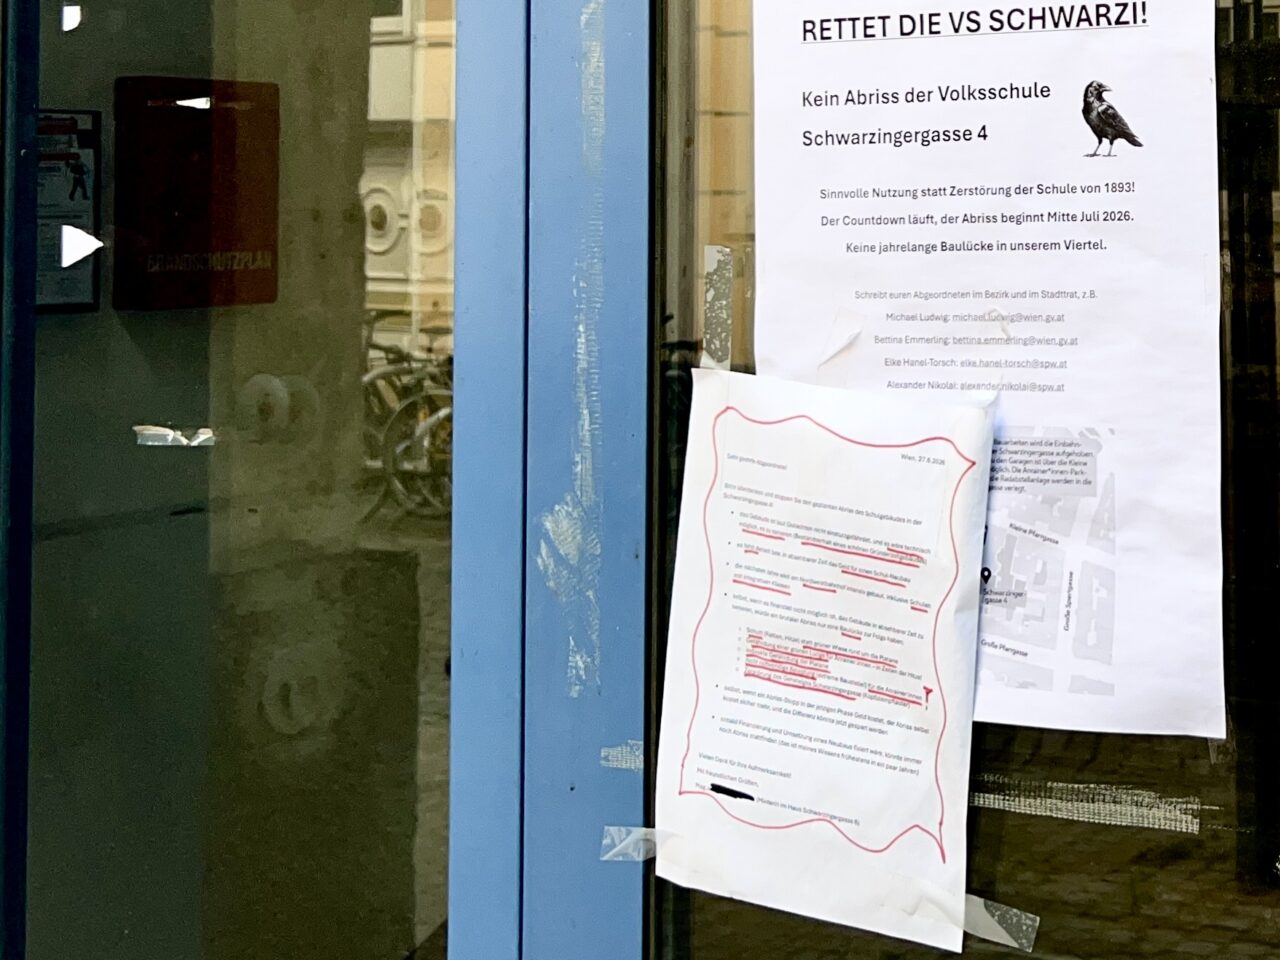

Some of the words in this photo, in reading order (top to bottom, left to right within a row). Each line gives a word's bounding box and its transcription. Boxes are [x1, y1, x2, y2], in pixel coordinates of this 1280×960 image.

[802, 15, 891, 40] RETTET
[899, 12, 941, 35] DIE
[948, 10, 981, 32] VS
[988, 0, 1148, 30] SCHWARZI!
[802, 90, 839, 107] Kein
[844, 88, 899, 105] Abriss
[904, 87, 934, 103] der
[937, 82, 1051, 101] Volksschule
[802, 128, 972, 147] Schwarzingergasse
[976, 124, 988, 140] 4
[819, 188, 869, 199] Sinnvolle
[871, 187, 918, 200] Nutzung
[920, 186, 947, 197] statt
[948, 185, 1012, 197] Zerstörung
[1013, 184, 1034, 195] der
[1036, 183, 1077, 194] Schule
[1079, 184, 1101, 193] von
[1103, 181, 1135, 193] 1893!
[820, 215, 840, 226] Der
[842, 215, 905, 225] Countdown
[907, 213, 937, 225] läuft,
[940, 213, 960, 224] der
[960, 212, 998, 223] Abriss
[1000, 211, 1044, 225] beginnt
[1046, 211, 1078, 222] Mitte
[1079, 210, 1100, 222] Juli
[1101, 210, 1134, 221] 2026.
[845, 242, 876, 252] Keine
[878, 241, 938, 254] jahrelange
[939, 240, 994, 251] Baulücke
[996, 239, 1007, 251] in
[1009, 241, 1061, 251] unserem
[1062, 238, 1107, 250] Viertel.
